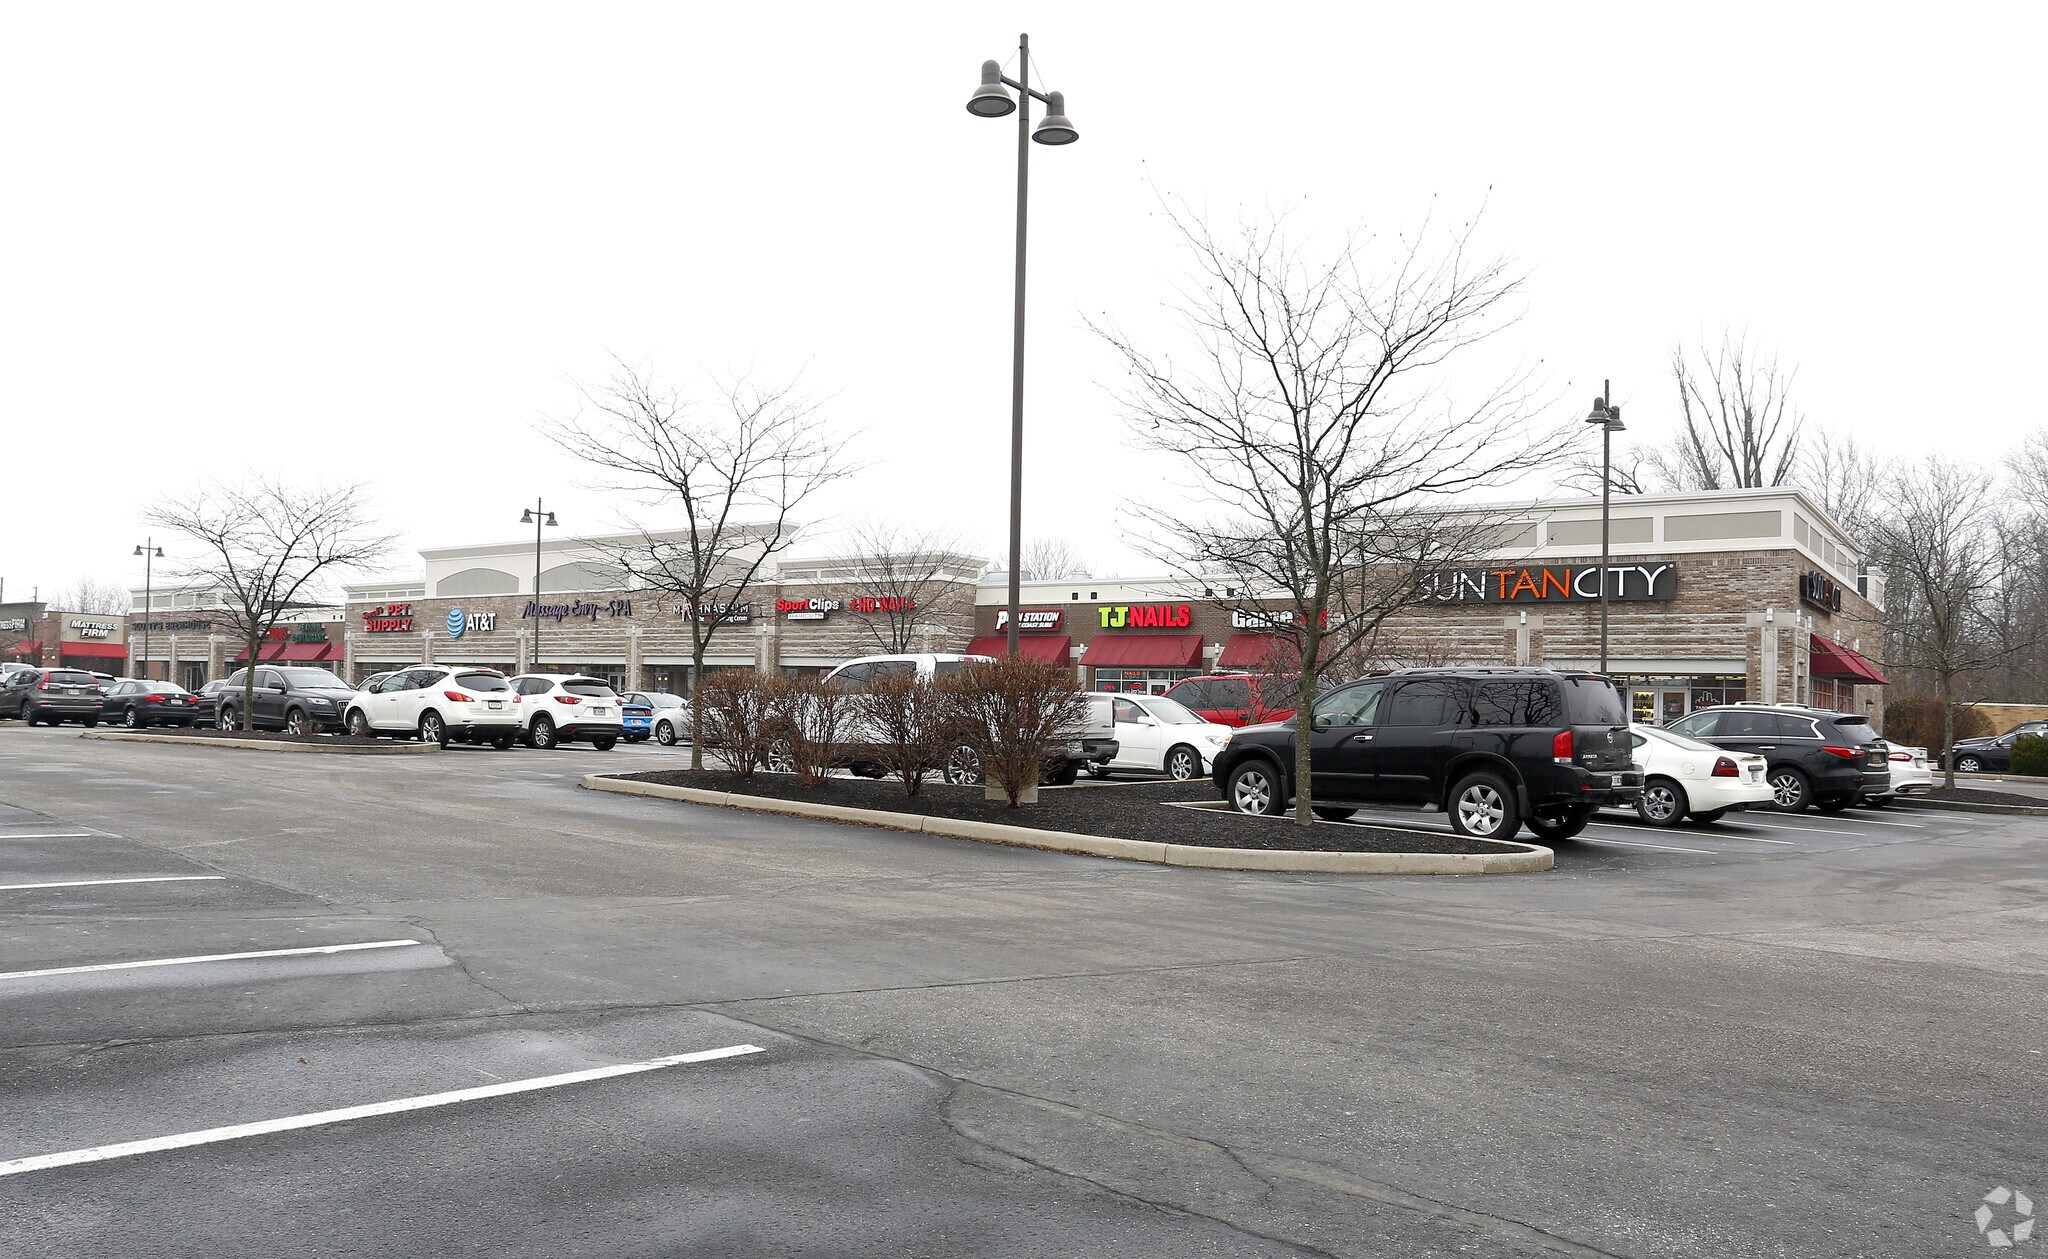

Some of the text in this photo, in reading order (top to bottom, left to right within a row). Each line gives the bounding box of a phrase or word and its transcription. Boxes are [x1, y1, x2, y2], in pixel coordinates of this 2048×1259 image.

[387, 604, 411, 616] PET
[572, 600, 598, 621] Envy
[610, 600, 633, 617] SPA
[466, 613, 496, 631] AT&T
[1023, 612, 1059, 622] STATION
[1098, 605, 1190, 628] TJ NAILS
[71, 619, 118, 630] MATTRESS
[366, 619, 413, 632] SUPPLY
[82, 629, 108, 637] FIRM
